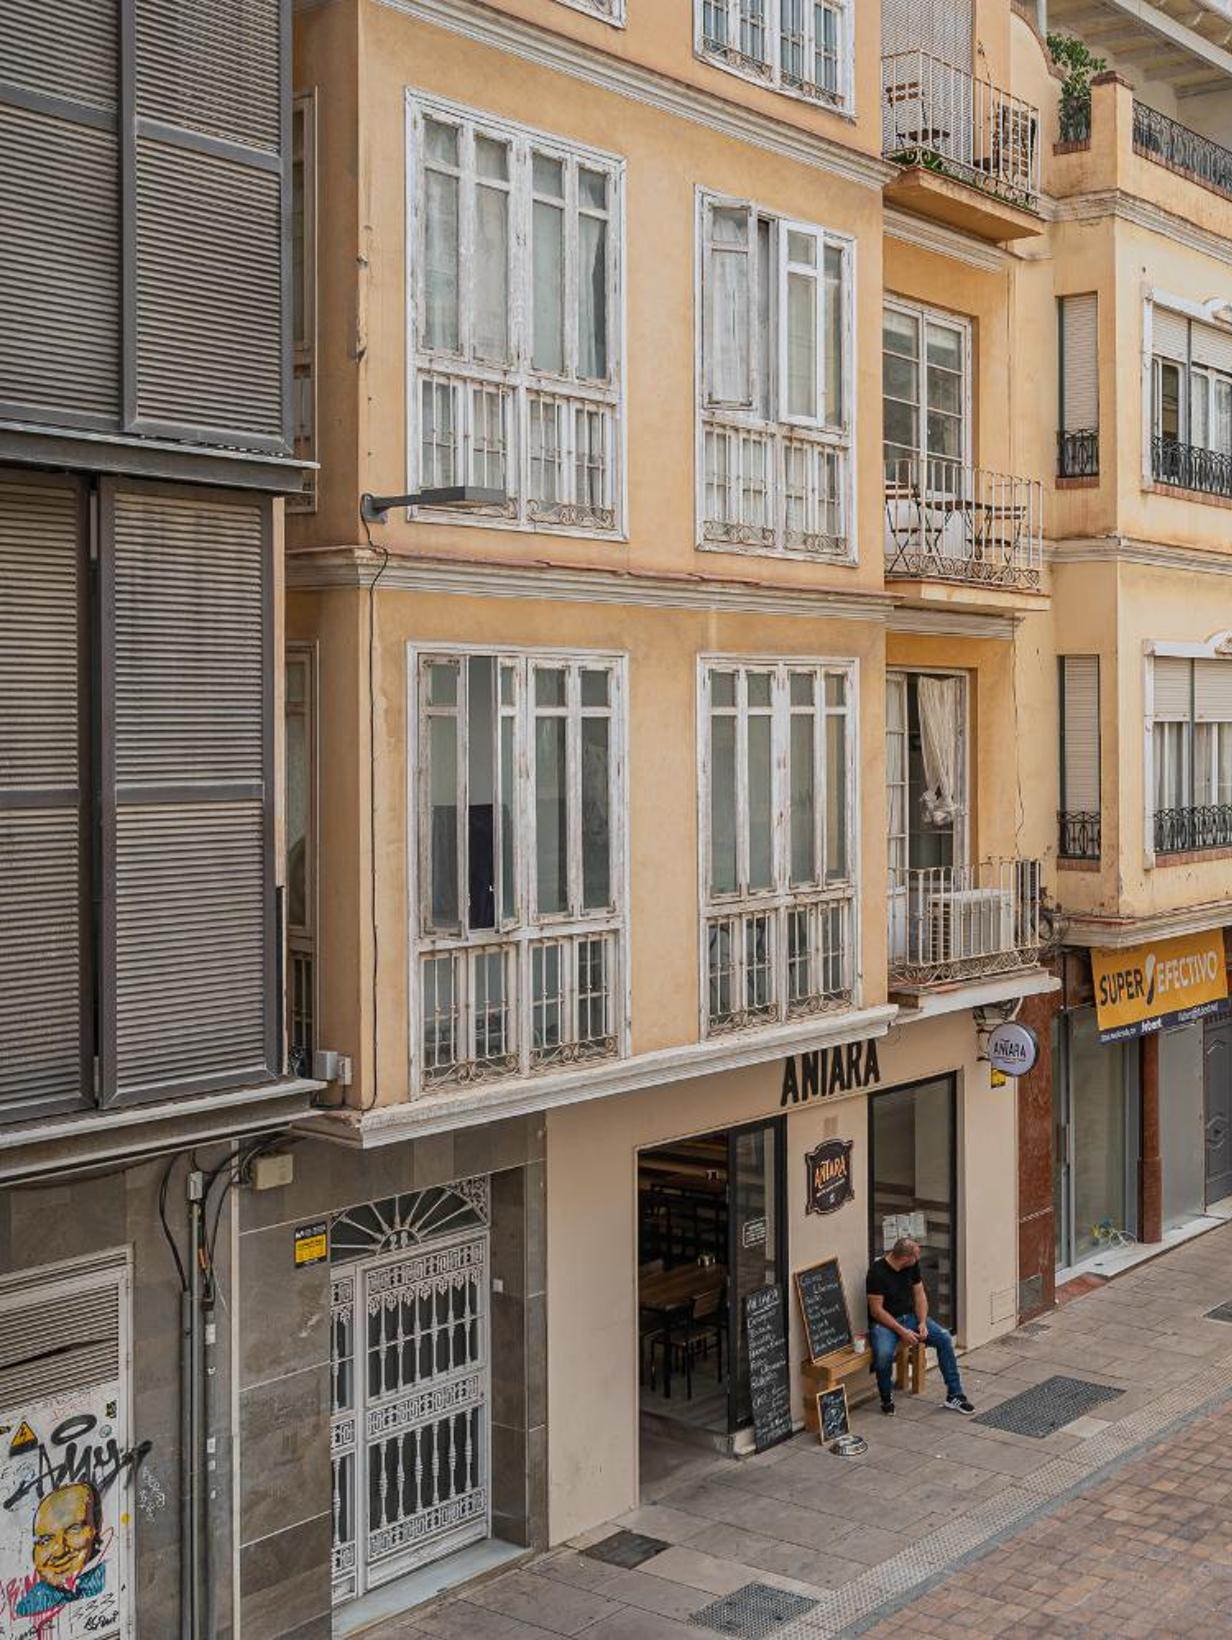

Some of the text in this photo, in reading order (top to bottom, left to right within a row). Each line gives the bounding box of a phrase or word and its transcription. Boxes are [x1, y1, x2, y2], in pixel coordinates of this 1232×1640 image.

[1100, 951, 1218, 1006] SUPER EFECTIVO
[781, 1038, 881, 1107] ANIARA
